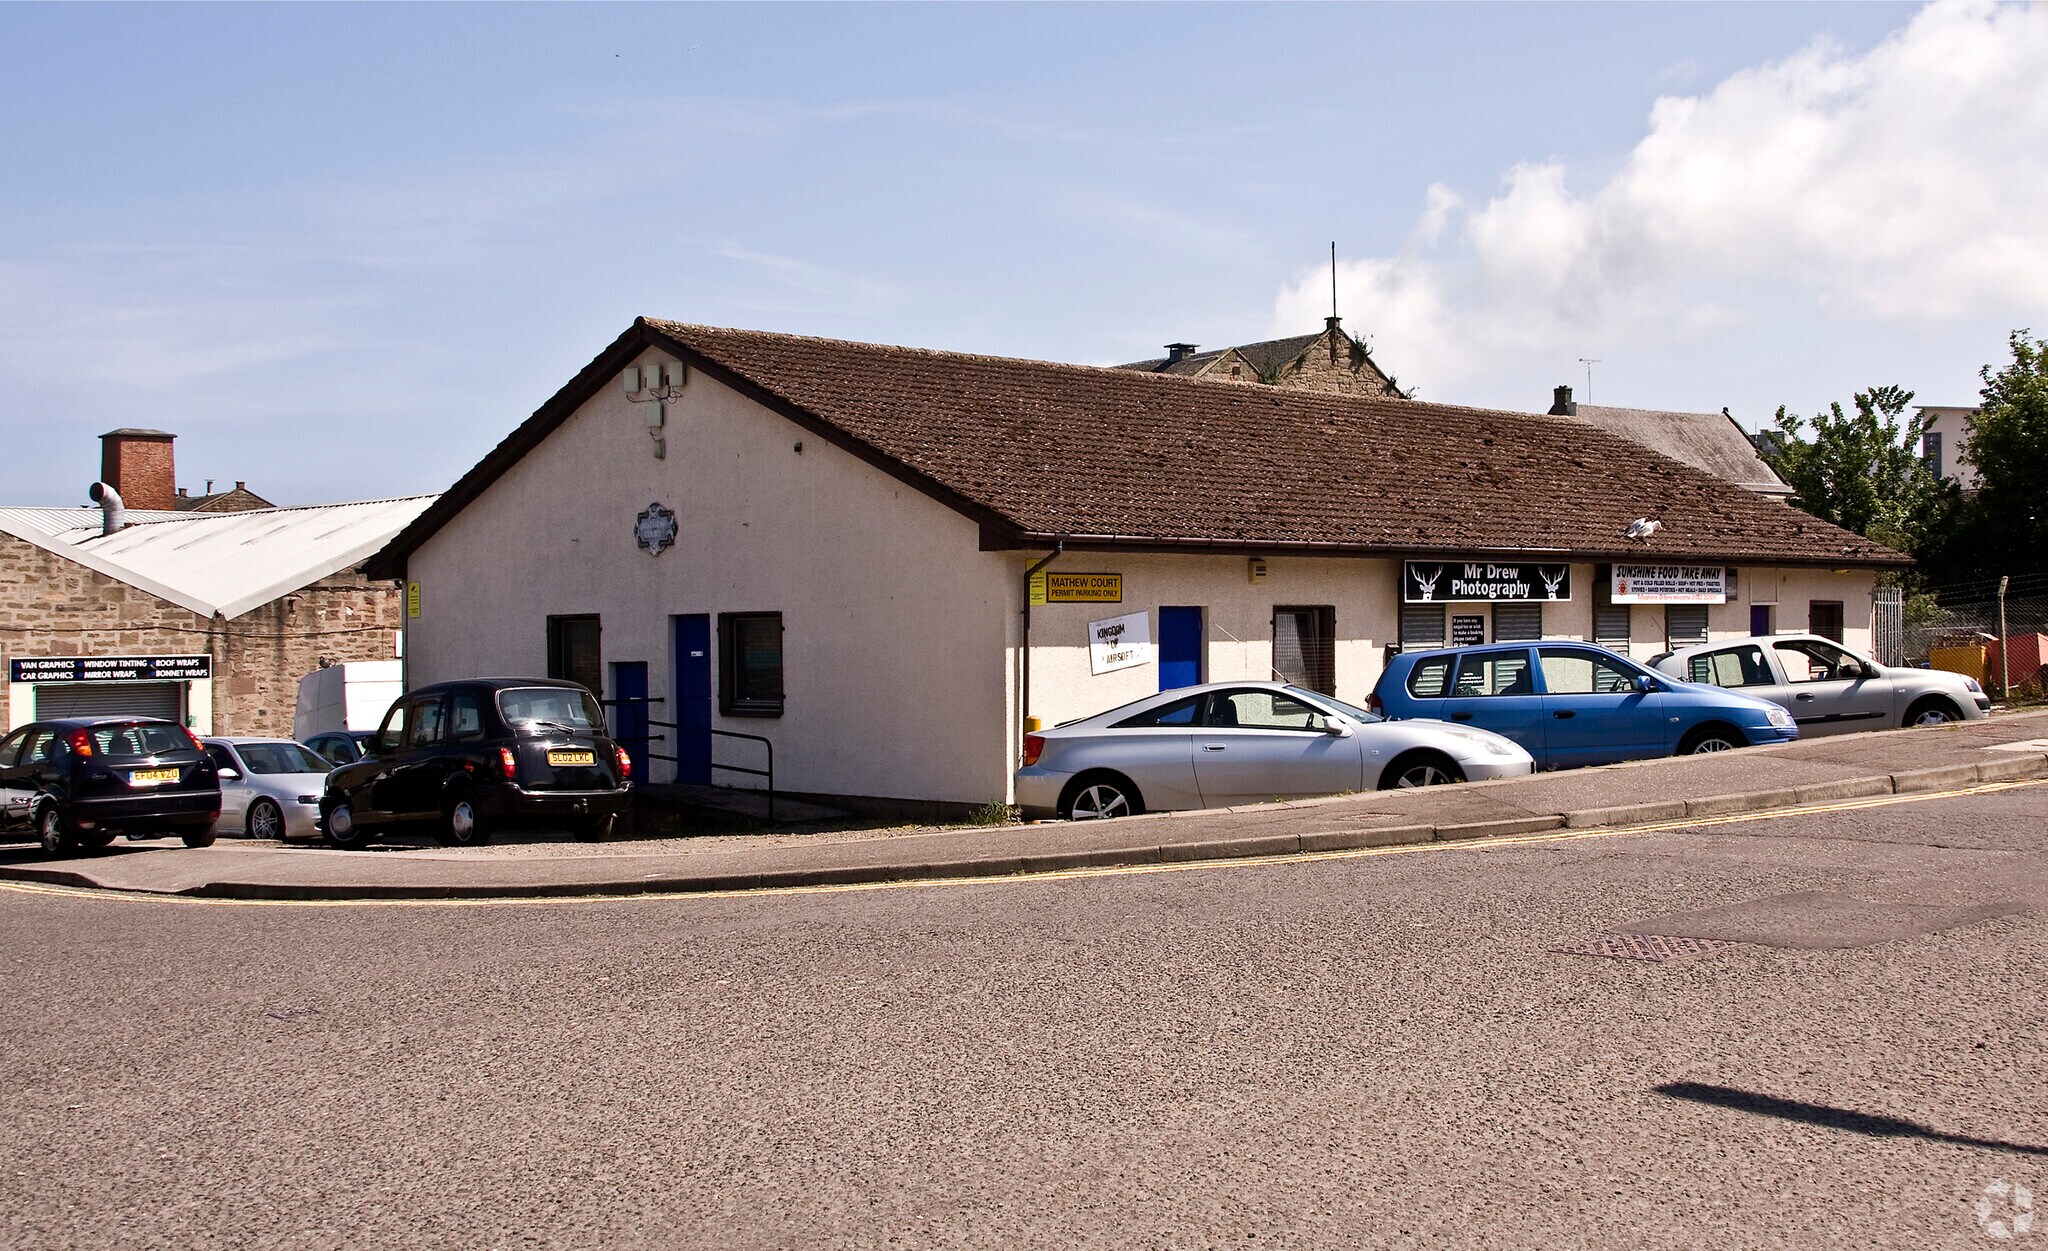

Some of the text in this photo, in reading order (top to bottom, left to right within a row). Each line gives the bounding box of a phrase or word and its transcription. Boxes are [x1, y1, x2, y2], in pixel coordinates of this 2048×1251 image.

[1464, 563, 1519, 579] Mr Drew
[1616, 565, 1721, 580] SUNSHINE FOOD TAKE AWAY
[1051, 578, 1088, 588] MATHEW
[1090, 578, 1118, 588] COURT
[1452, 580, 1530, 598] Photography
[1097, 623, 1126, 639] KINGDOM
[1106, 650, 1134, 664] AIRSOFT
[38, 661, 75, 669] GRAPHICS
[84, 660, 118, 668] WINDOW
[20, 671, 75, 680] CAR GRAPHICS
[83, 670, 137, 679] MIRROR WRAPS
[185, 669, 208, 677] WRAPS
[552, 753, 589, 761] SL02 LKC
